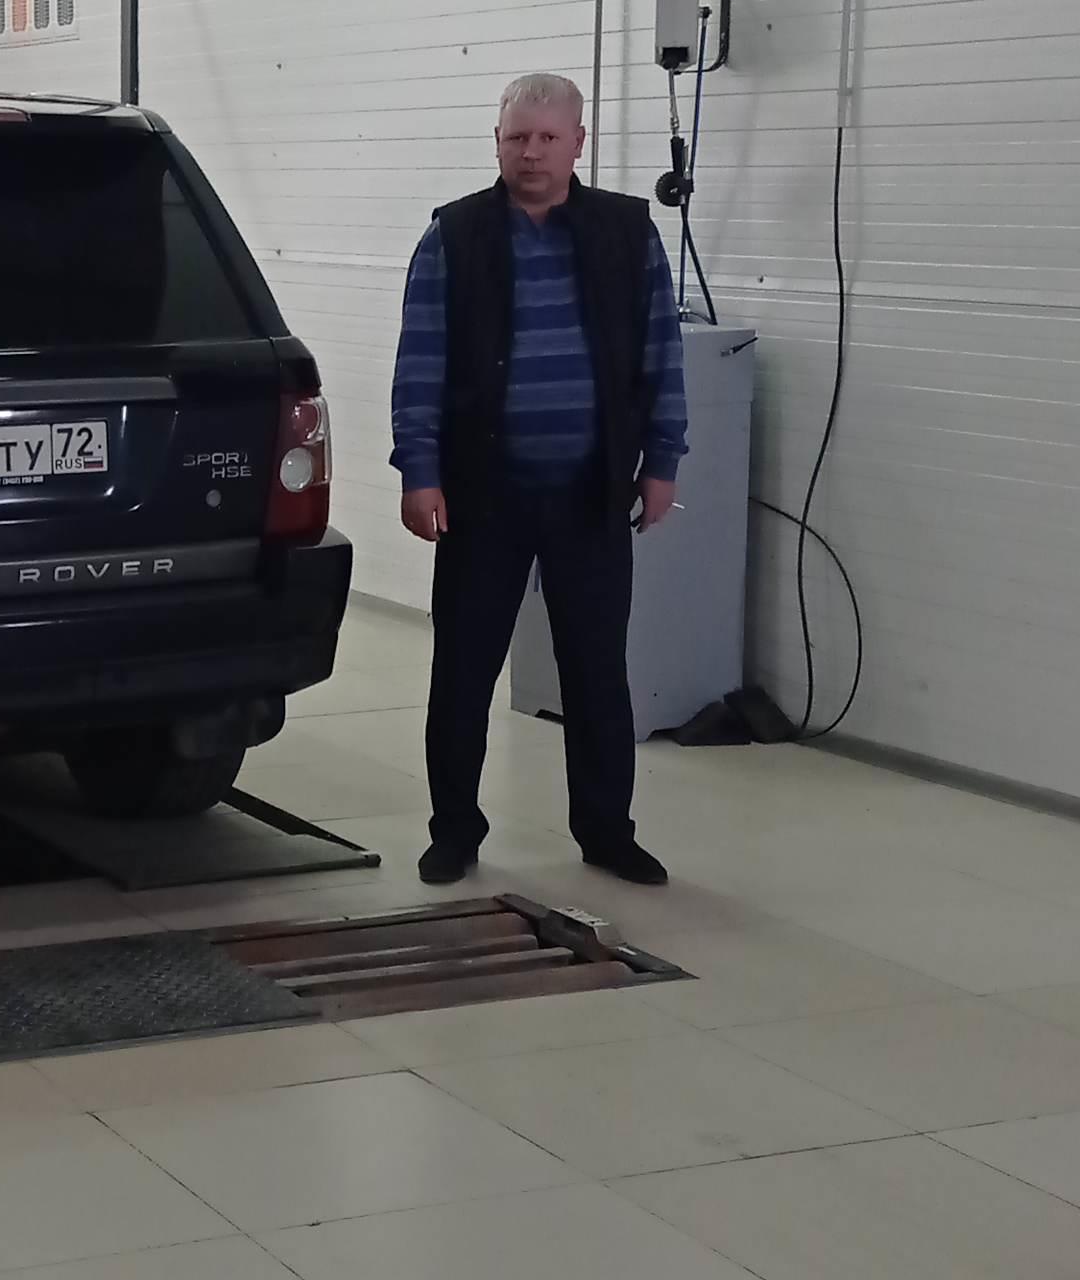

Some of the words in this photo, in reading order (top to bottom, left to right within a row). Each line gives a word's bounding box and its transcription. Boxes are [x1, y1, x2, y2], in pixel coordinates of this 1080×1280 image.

[56, 426, 94, 458] 72
[55, 458, 83, 470] RUS
[211, 465, 253, 479] HSE
[18, 558, 174, 584] ROVER
